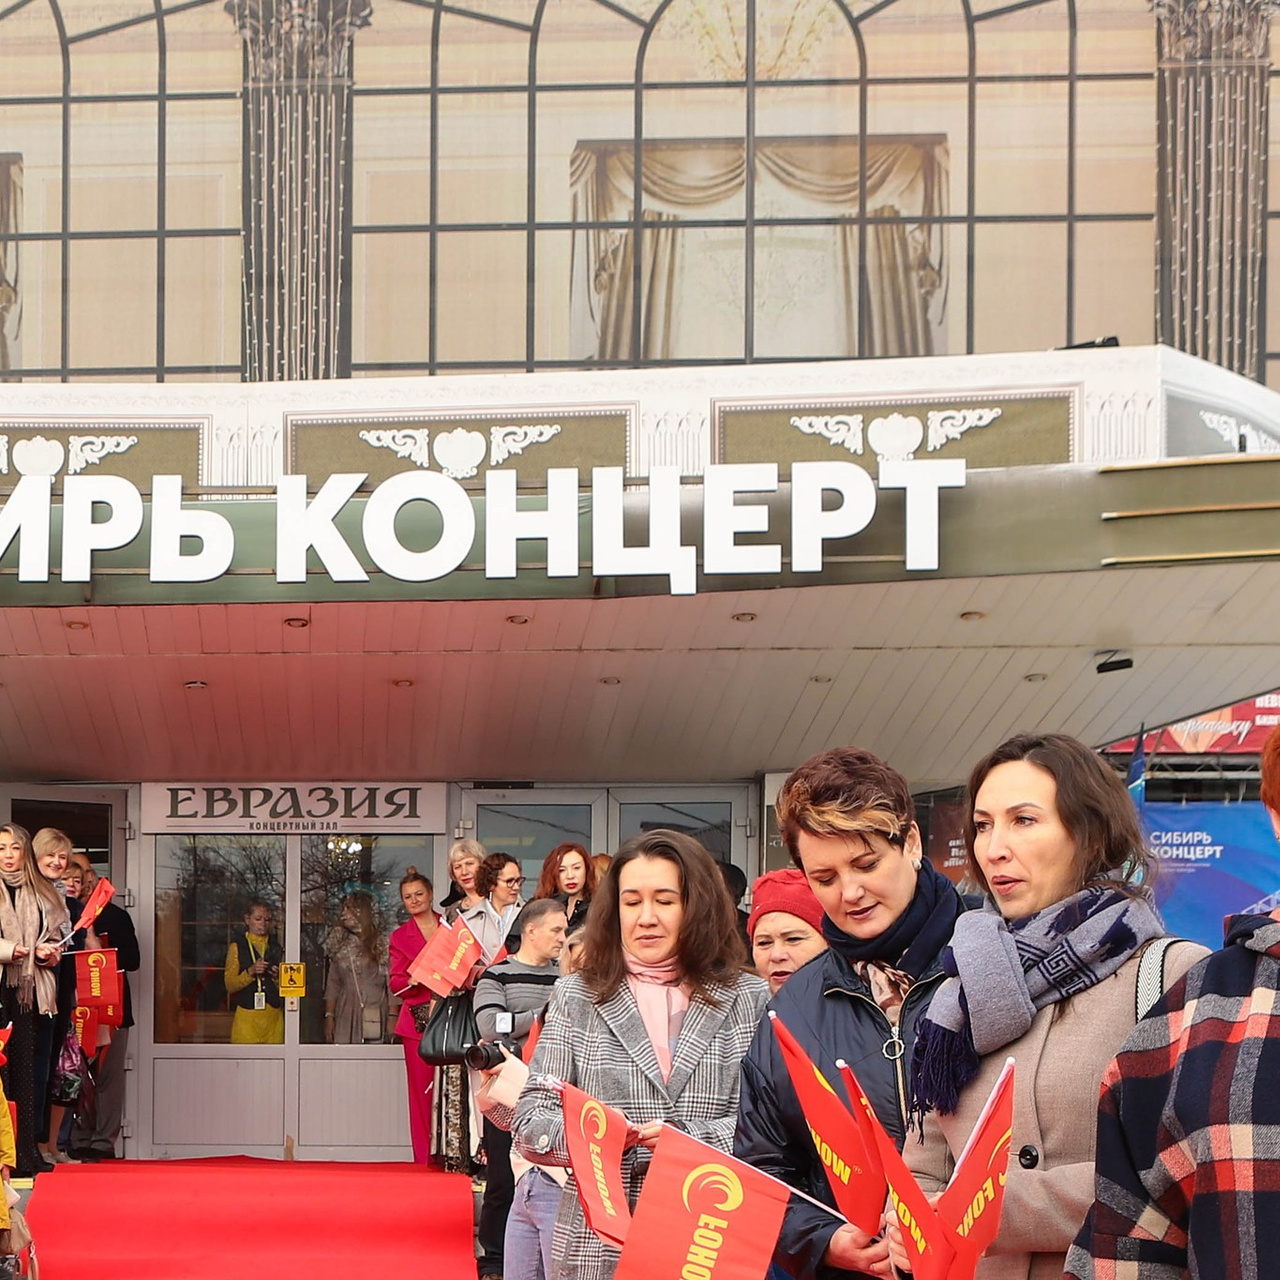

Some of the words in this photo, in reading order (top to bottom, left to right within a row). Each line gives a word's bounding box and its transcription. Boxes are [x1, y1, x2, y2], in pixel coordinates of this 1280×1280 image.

[275, 460, 967, 596] КОНЦЕРТ
[166, 787, 422, 819] ЕВРАЗИЯ
[249, 821, 316, 831] КОНЦЕРТНЫЙ
[320, 821, 338, 831] ЗАЛ
[1150, 831, 1212, 845] СИБИРЬ
[1150, 845, 1224, 861] КОНЦЕРТ
[90, 967, 102, 997] FOHOW
[810, 1127, 852, 1185] HOW
